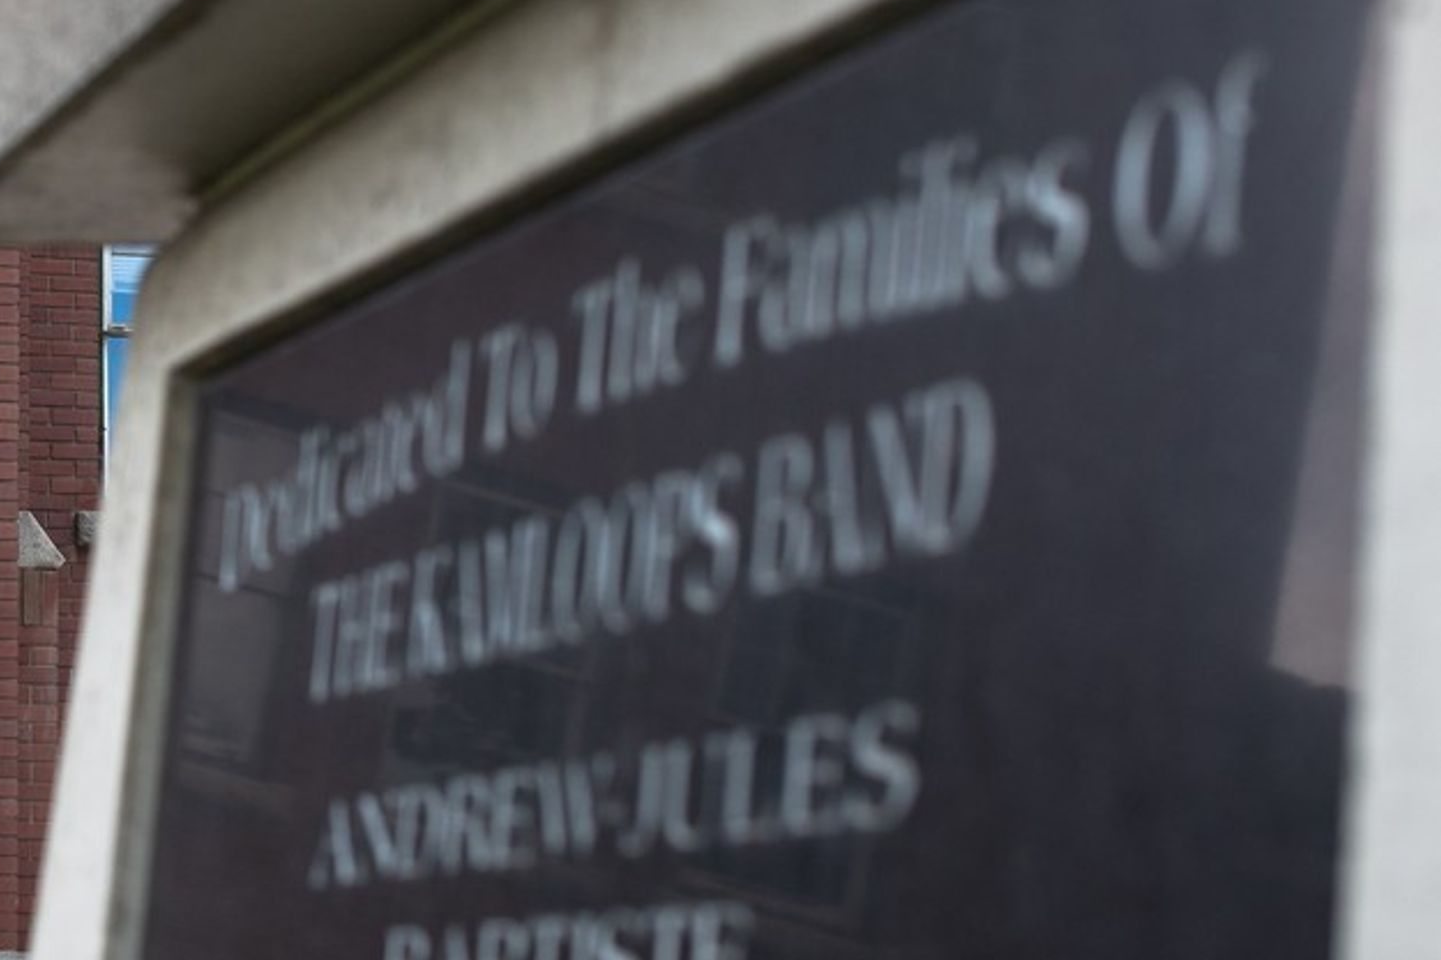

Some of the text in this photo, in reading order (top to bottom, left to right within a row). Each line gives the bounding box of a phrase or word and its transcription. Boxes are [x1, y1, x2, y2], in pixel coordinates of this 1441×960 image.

[478, 322, 560, 453] To
[572, 255, 706, 415] The
[713, 136, 1090, 368] Families
[1110, 45, 1270, 272] Of
[309, 377, 995, 705] THE KAMLOOPS BAND
[308, 700, 922, 892] ANDREW JULES
